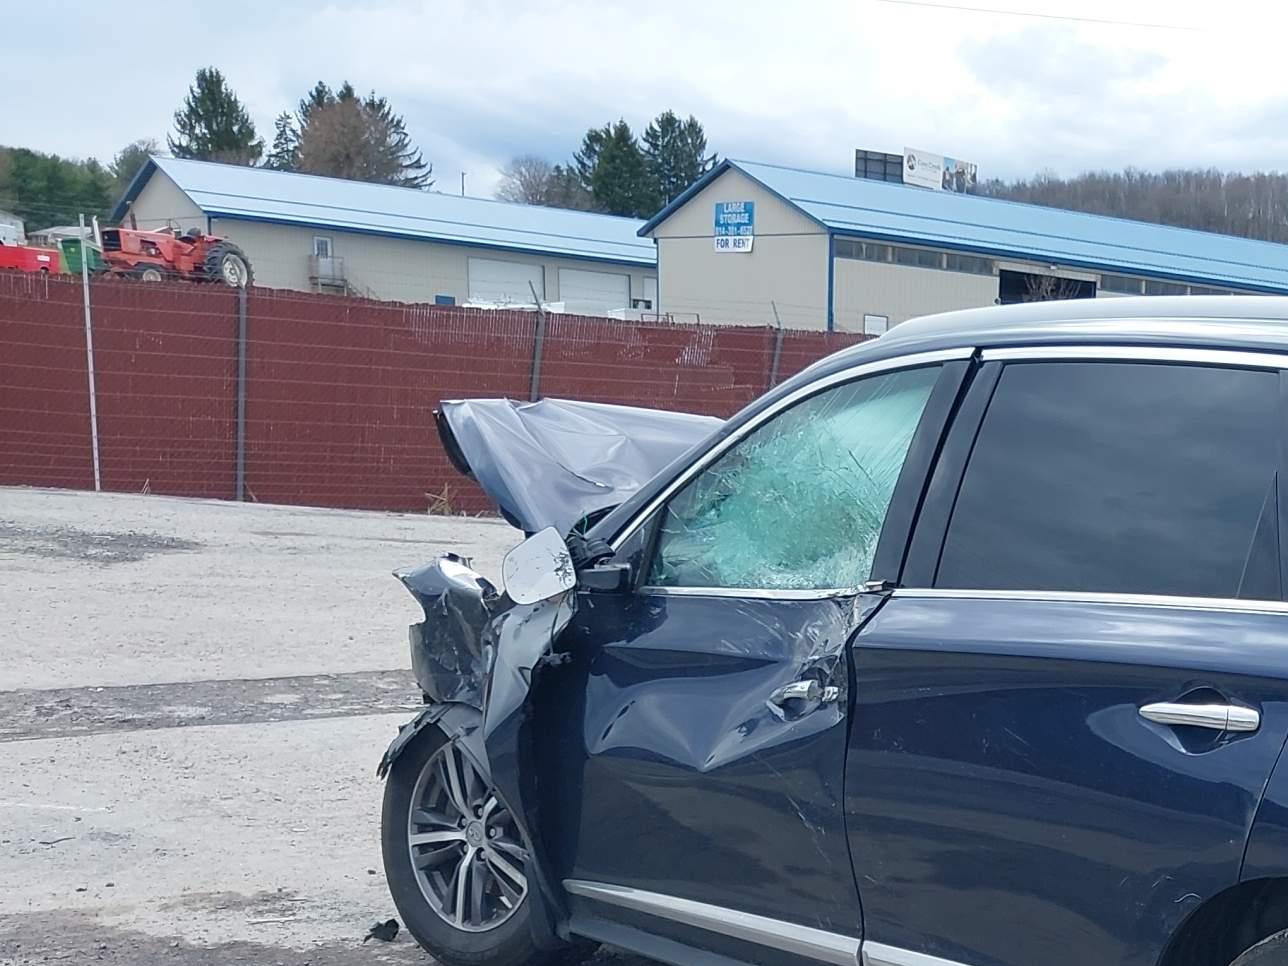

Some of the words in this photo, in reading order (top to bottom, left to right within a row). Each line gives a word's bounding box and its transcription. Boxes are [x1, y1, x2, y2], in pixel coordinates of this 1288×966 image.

[724, 202, 745, 213] LARGE
[719, 213, 750, 224] STORAGE
[716, 238, 730, 248] FOR
[733, 238, 750, 248] RENT
